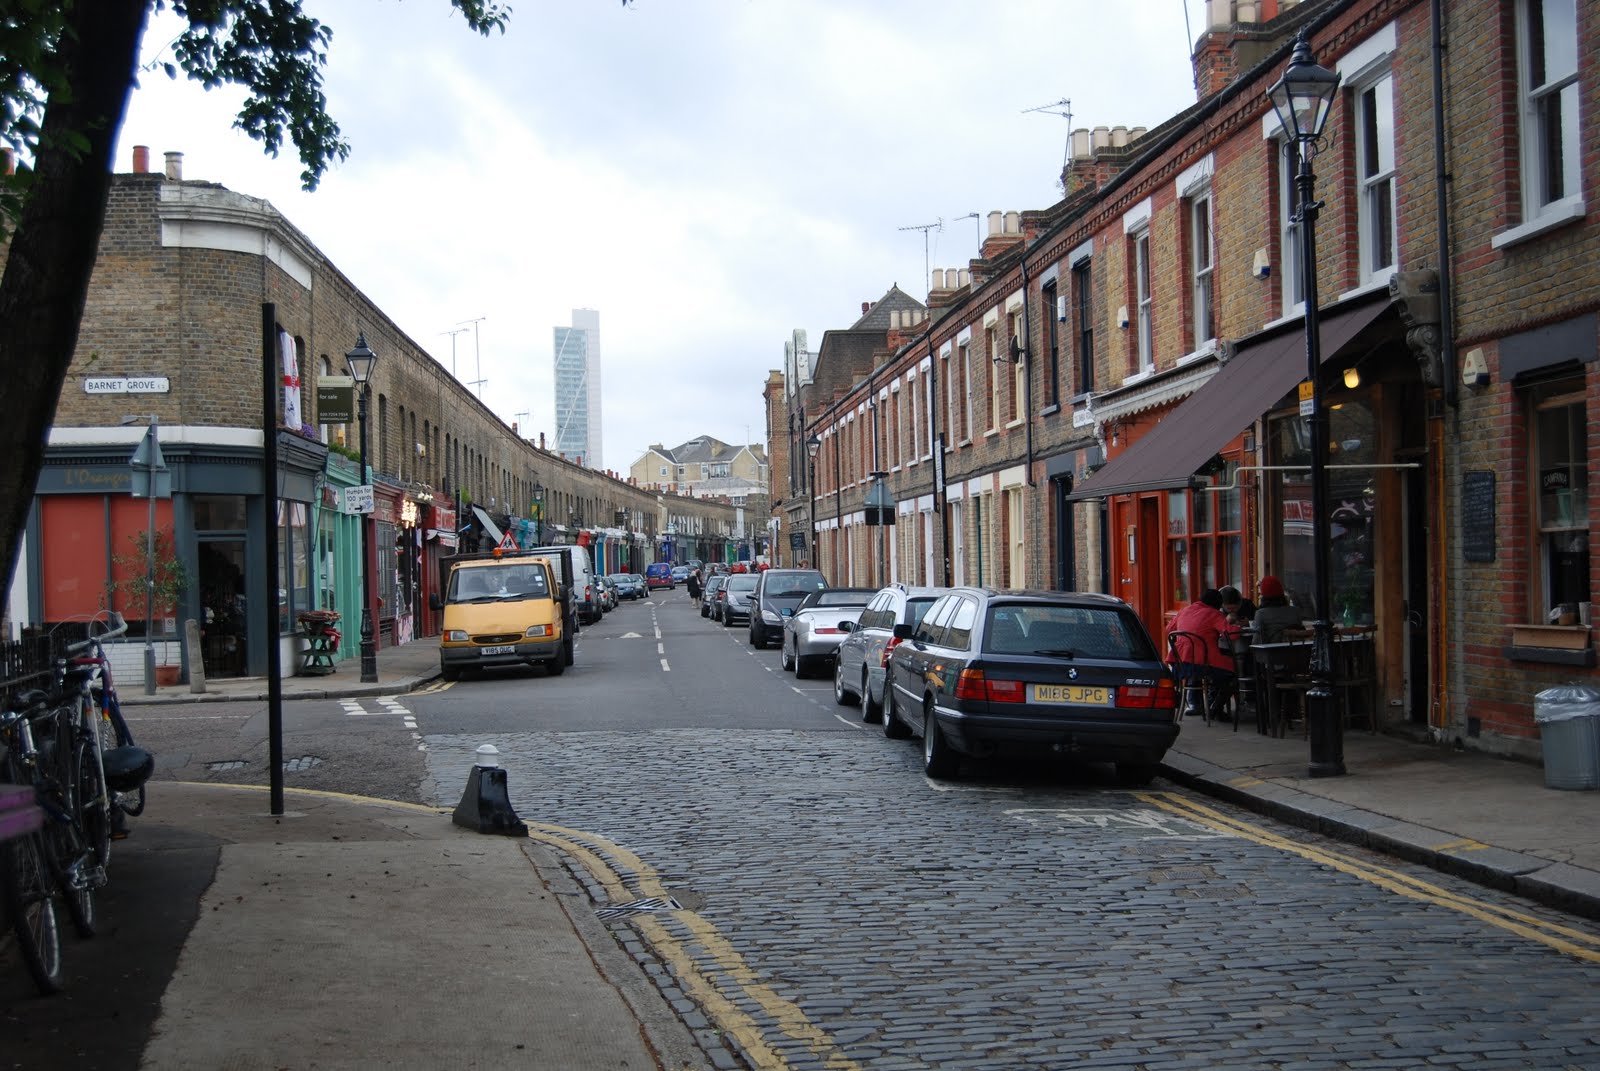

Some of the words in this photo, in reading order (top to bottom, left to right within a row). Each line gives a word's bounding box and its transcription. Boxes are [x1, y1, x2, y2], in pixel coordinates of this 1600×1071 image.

[88, 381, 122, 390] BARNET
[127, 381, 155, 390] GROVE
[359, 494, 372, 502] yards
[1038, 687, 1071, 700] M186
[1075, 688, 1103, 701] JPG
